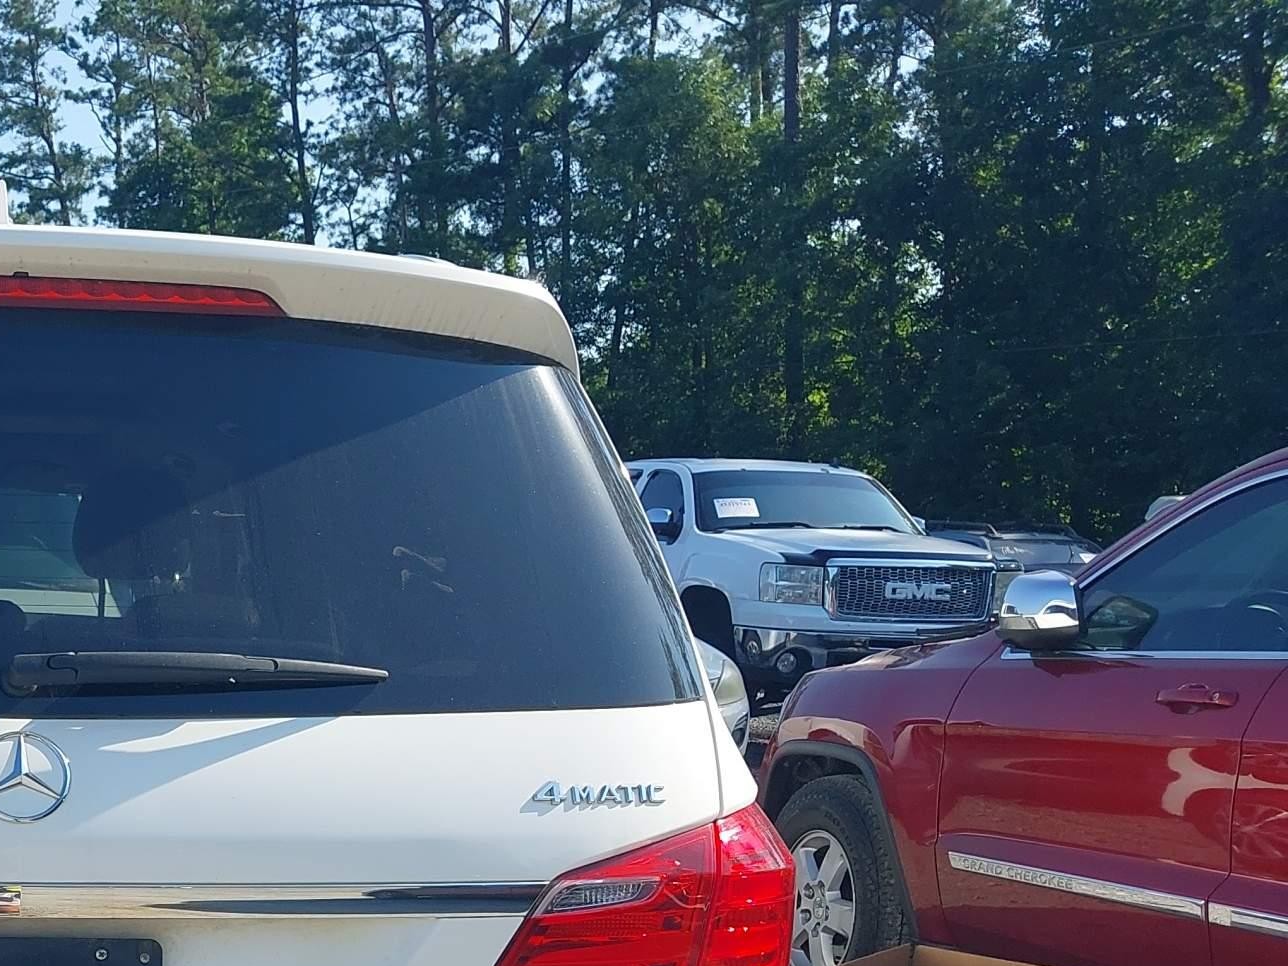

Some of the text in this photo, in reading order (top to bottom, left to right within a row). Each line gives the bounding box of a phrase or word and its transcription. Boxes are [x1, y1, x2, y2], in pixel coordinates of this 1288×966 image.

[885, 582, 952, 600] GMC
[532, 781, 666, 806] 4MATIC
[962, 858, 1073, 889] GRAND CHEROKEE
